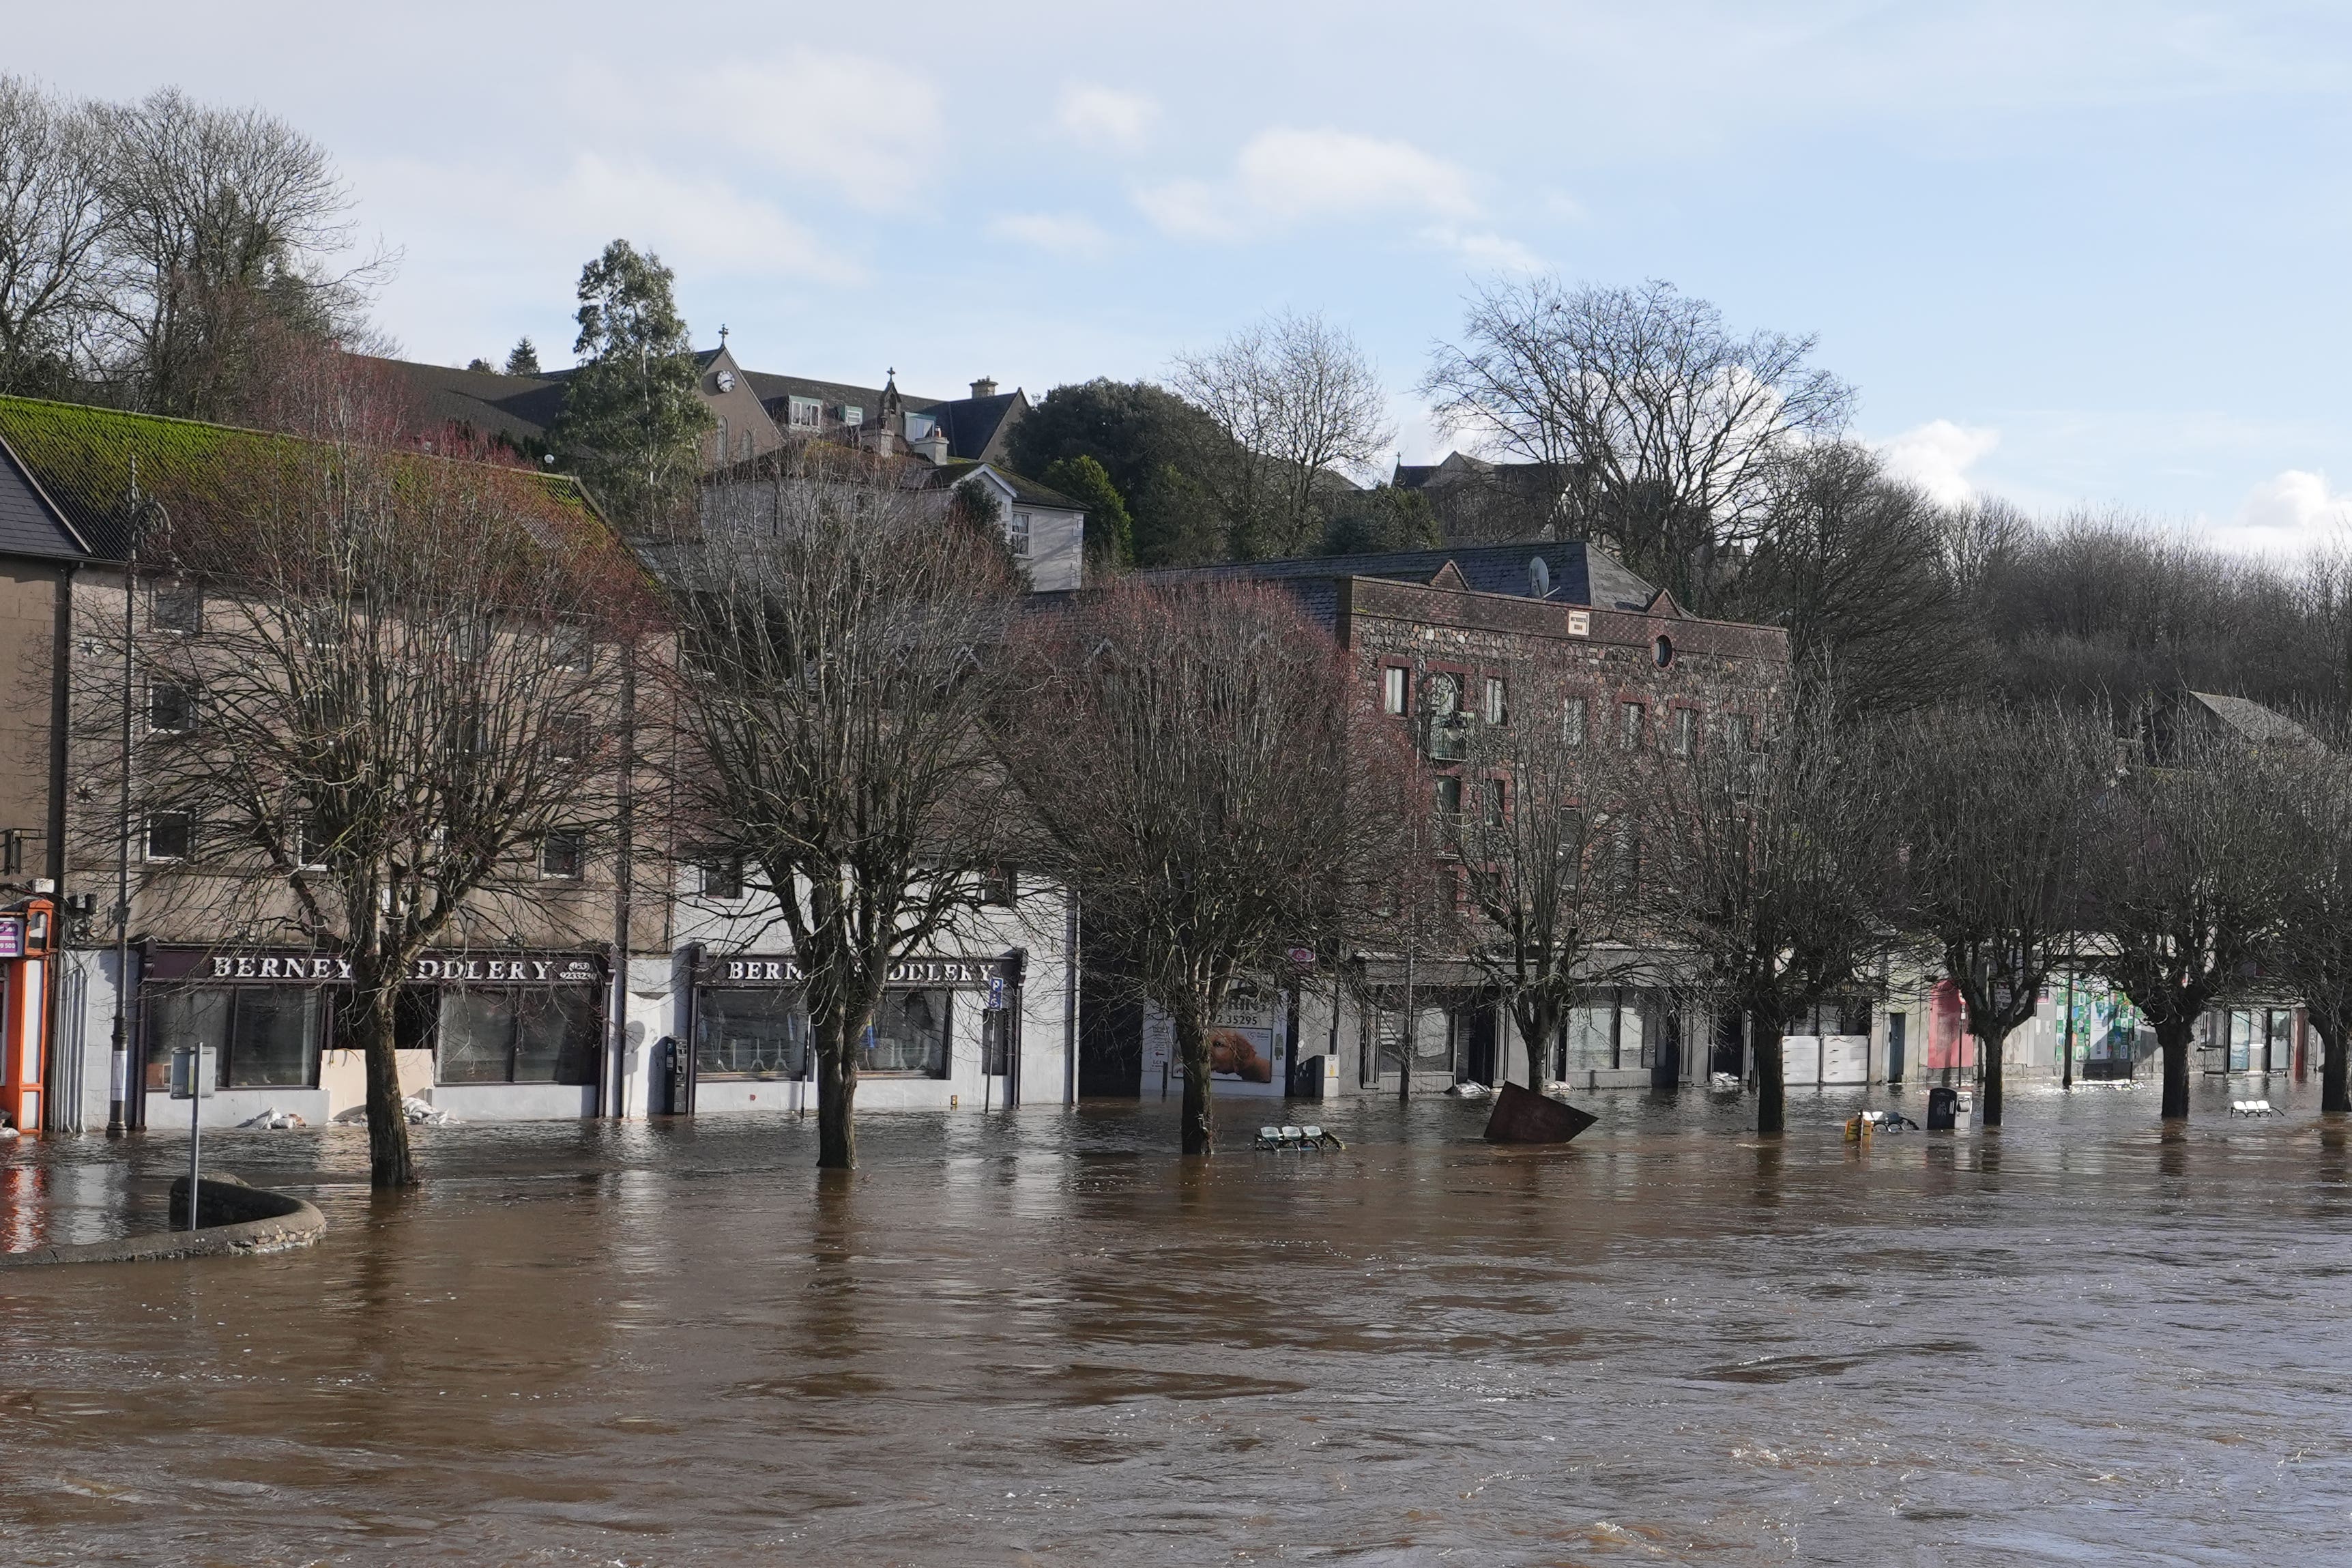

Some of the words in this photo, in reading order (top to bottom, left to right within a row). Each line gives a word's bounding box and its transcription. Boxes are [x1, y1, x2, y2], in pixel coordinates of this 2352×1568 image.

[213, 957, 351, 978] BERNEY
[405, 959, 553, 980] DDLERY
[1227, 1015, 1258, 1026] 35295
